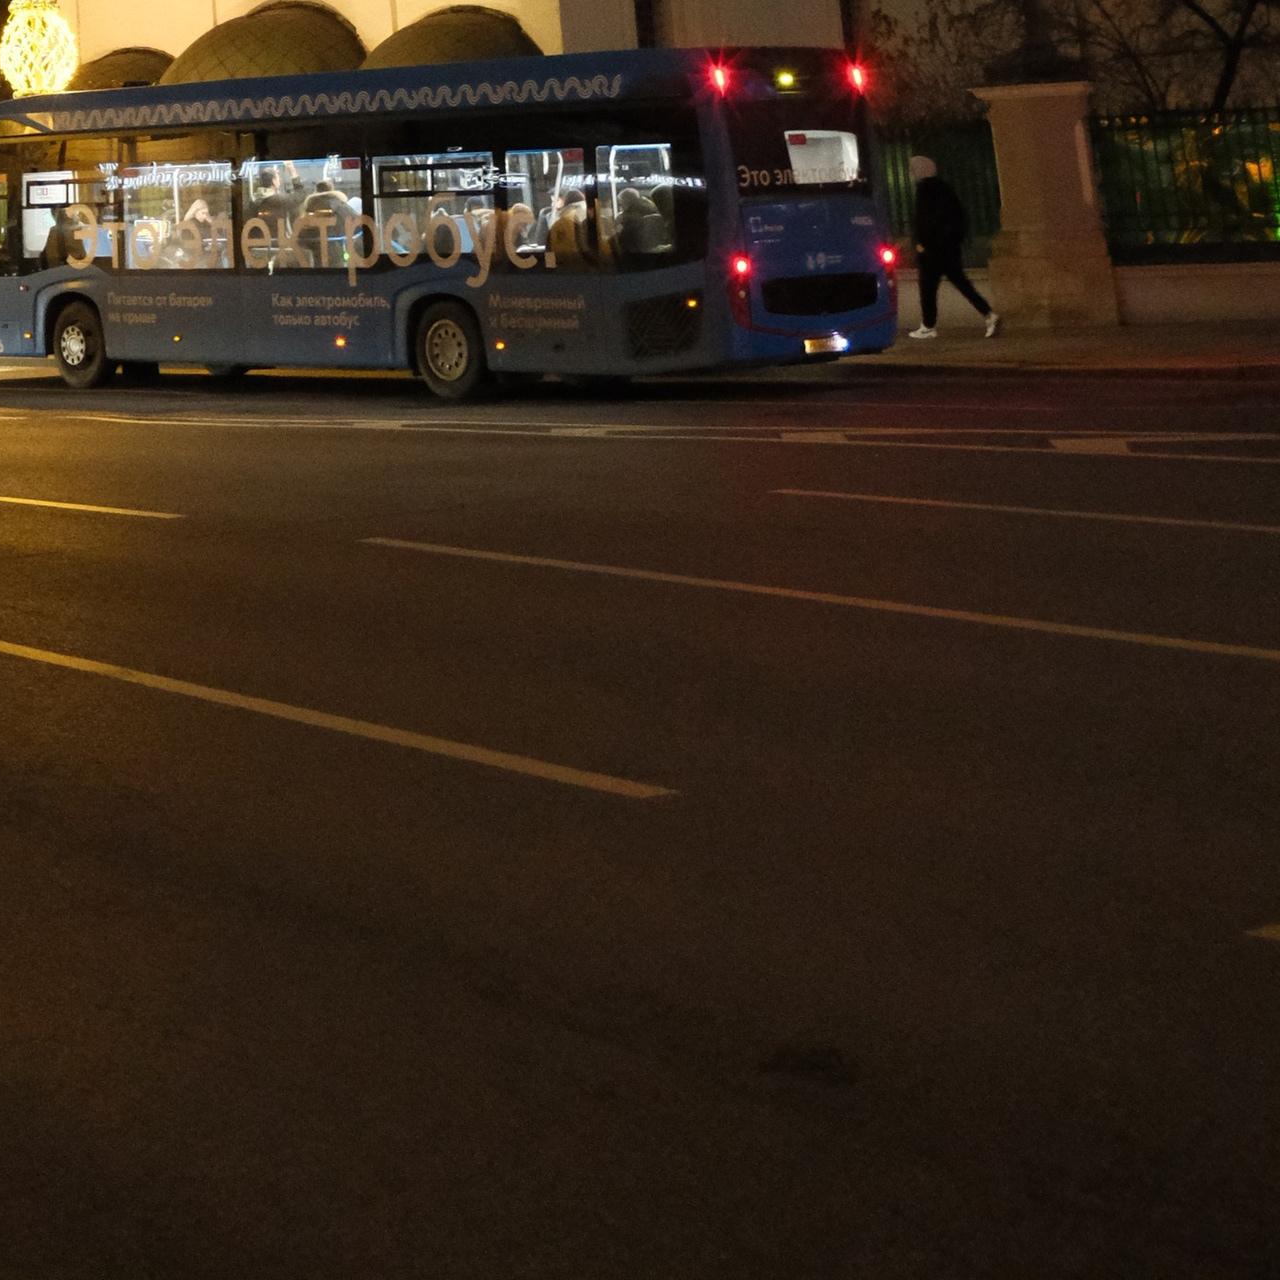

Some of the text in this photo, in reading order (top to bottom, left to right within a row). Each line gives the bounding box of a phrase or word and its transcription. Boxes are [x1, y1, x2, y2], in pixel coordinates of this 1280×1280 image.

[737, 165, 770, 187] Это
[65, 183, 555, 288] Это электробус.
[107, 292, 213, 308] Питается от батареи
[271, 293, 391, 310] Как электромобиль,
[272, 311, 360, 330] только автобус
